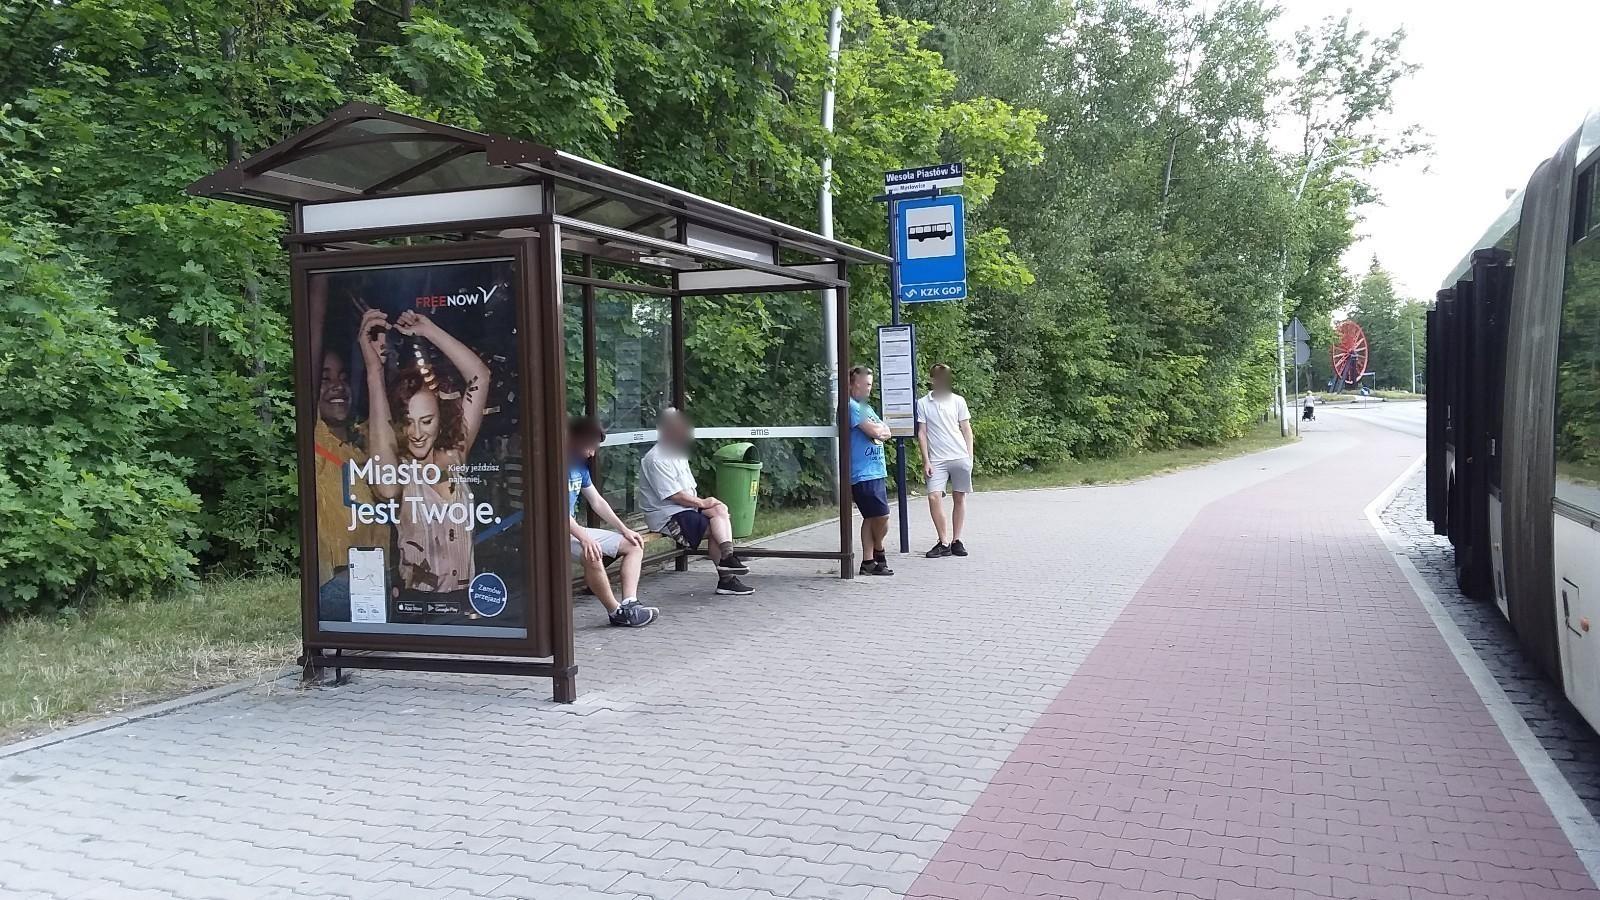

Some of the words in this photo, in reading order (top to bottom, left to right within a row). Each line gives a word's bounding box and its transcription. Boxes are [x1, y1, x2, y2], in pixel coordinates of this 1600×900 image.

[916, 167, 949, 179] Piastów
[920, 288, 940, 297] KZK
[941, 286, 962, 295] GOP
[415, 293, 479, 308] FREENOW
[751, 428, 770, 436] ams
[350, 455, 441, 485] Miasto
[448, 463, 470, 473] Kiedy
[471, 463, 500, 473] jeździsz
[347, 494, 401, 531] jest
[405, 493, 502, 531] Twoje.
[478, 583, 502, 595] Zamów
[474, 593, 501, 604] przejazd
